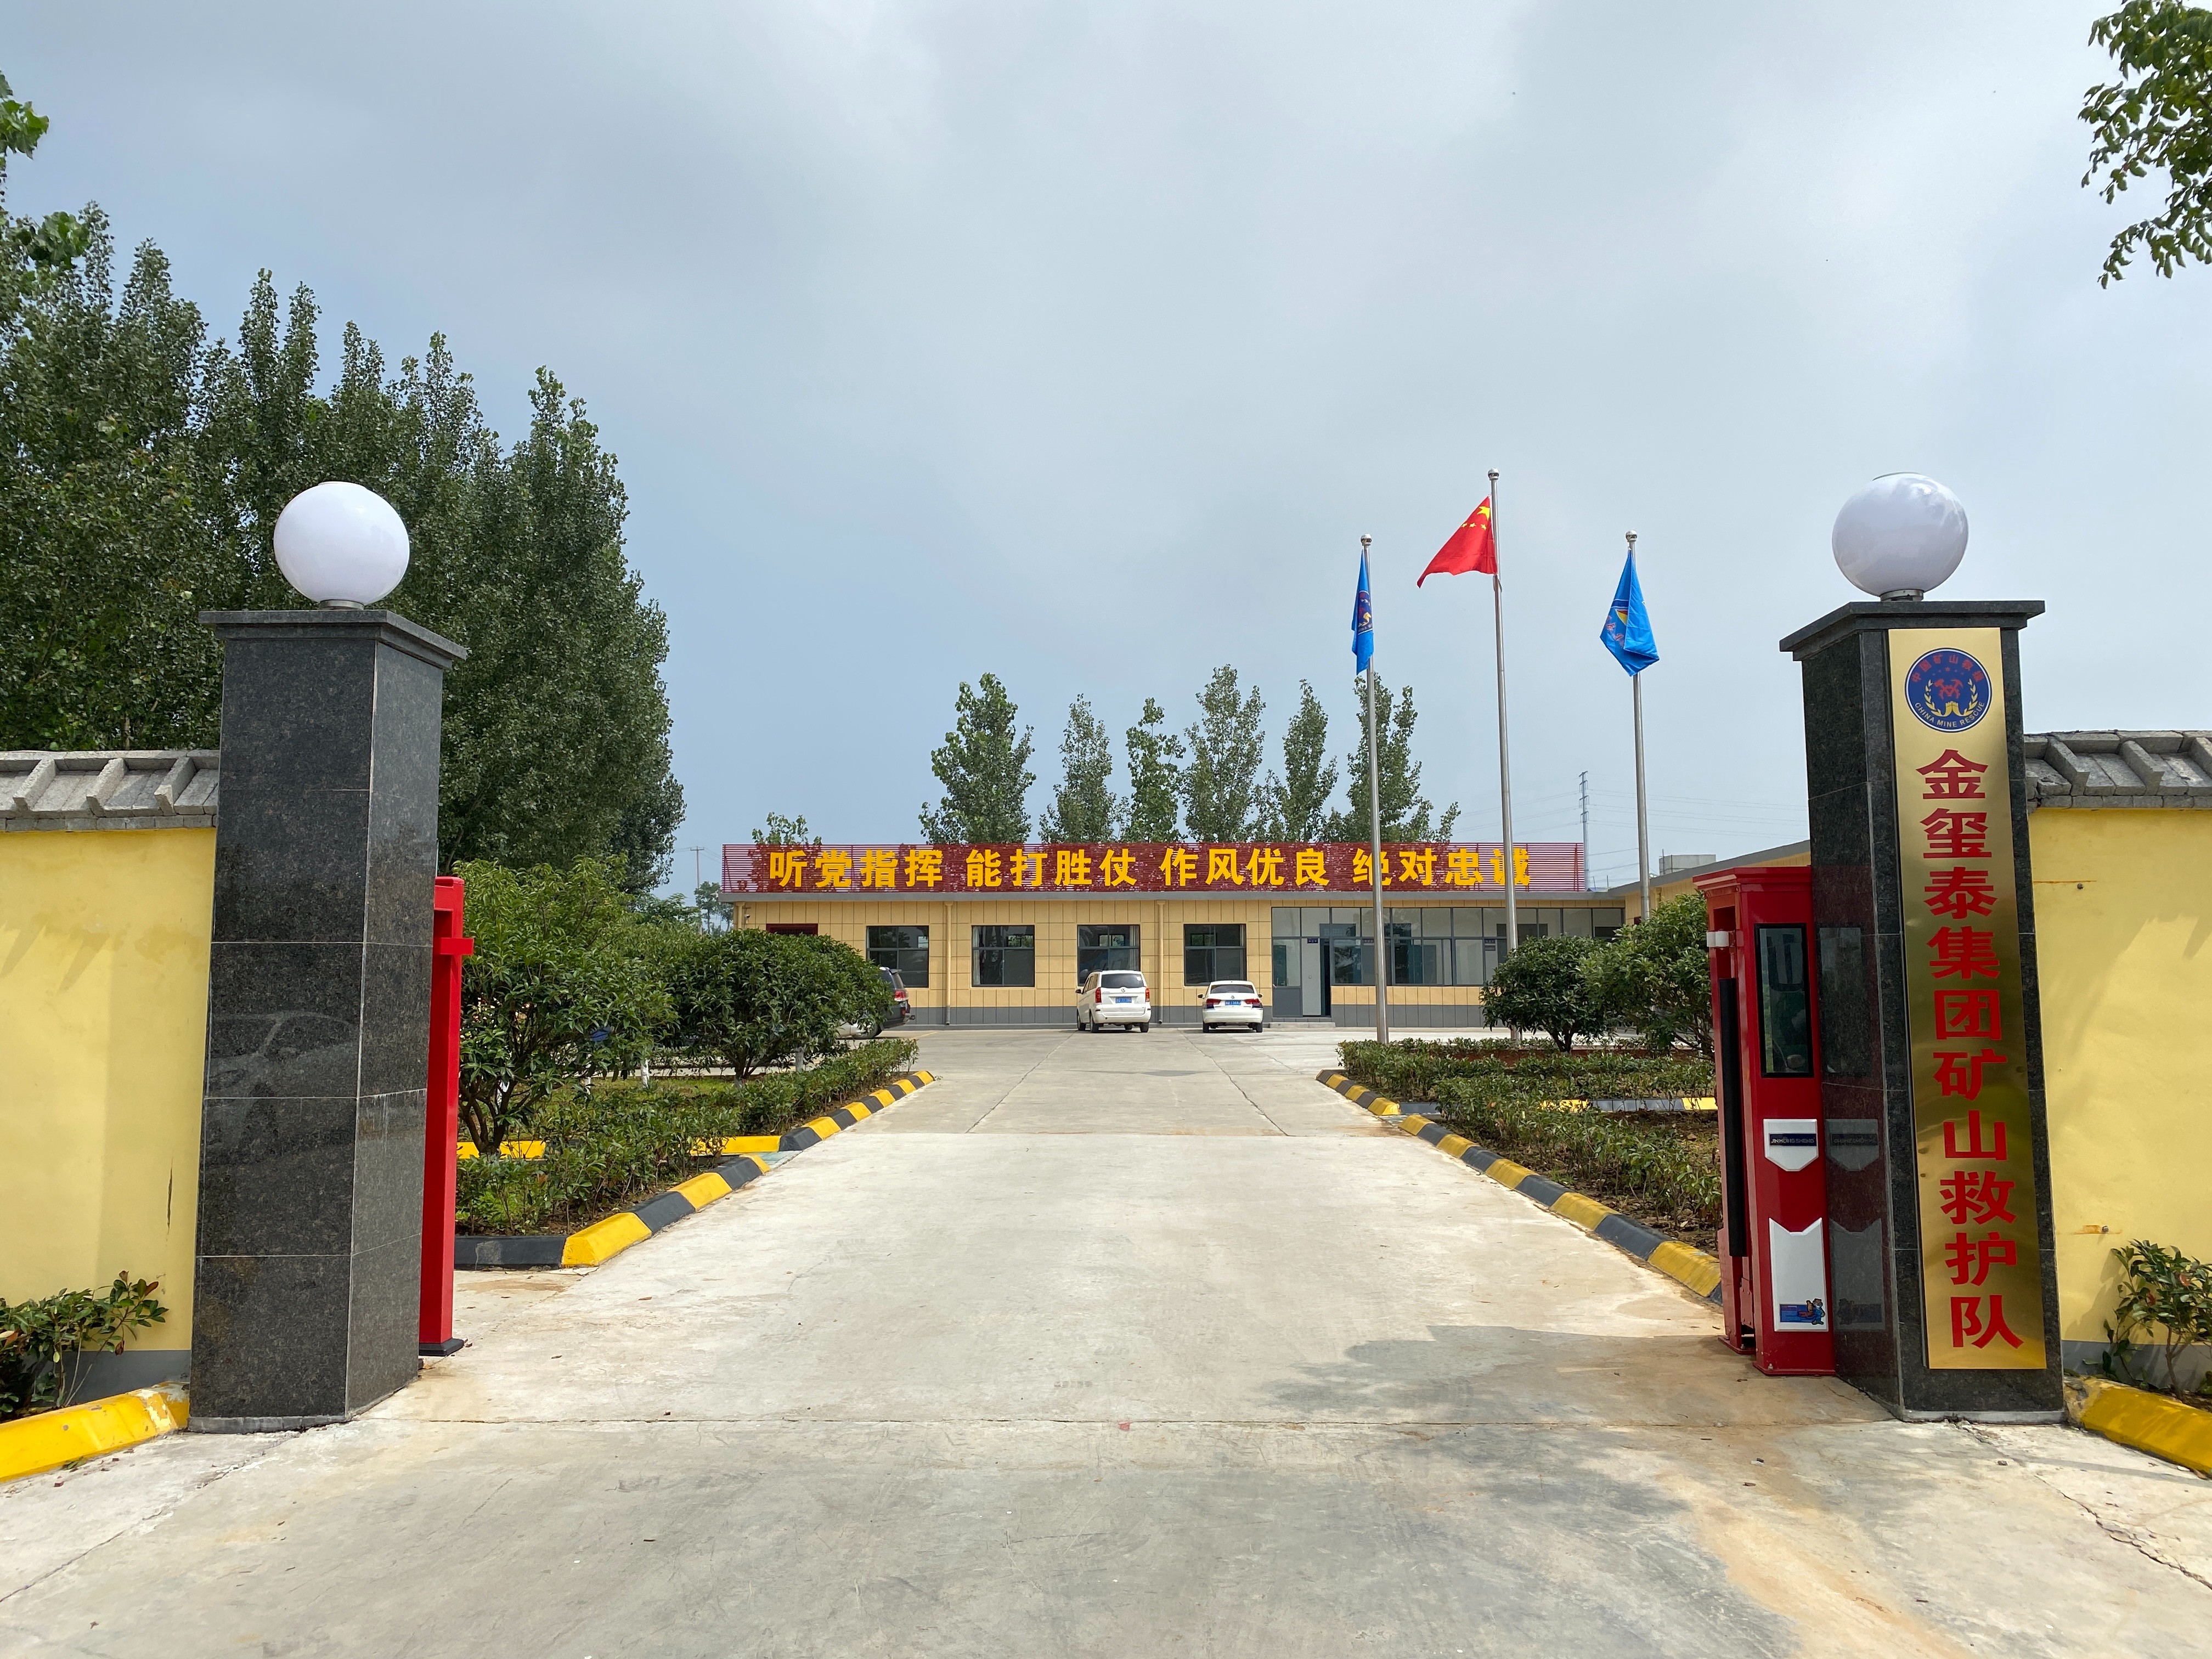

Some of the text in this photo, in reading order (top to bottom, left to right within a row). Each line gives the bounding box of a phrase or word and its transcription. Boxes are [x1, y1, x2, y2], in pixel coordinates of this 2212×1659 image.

[1915, 702, 1985, 727] CHINA MINE RESCUE
[769, 848, 1531, 888] 听党指挥 能打胜仗 作风优良 绝对忠诚
[1915, 748, 2024, 1350] 金玺泰集团矿山救护队
